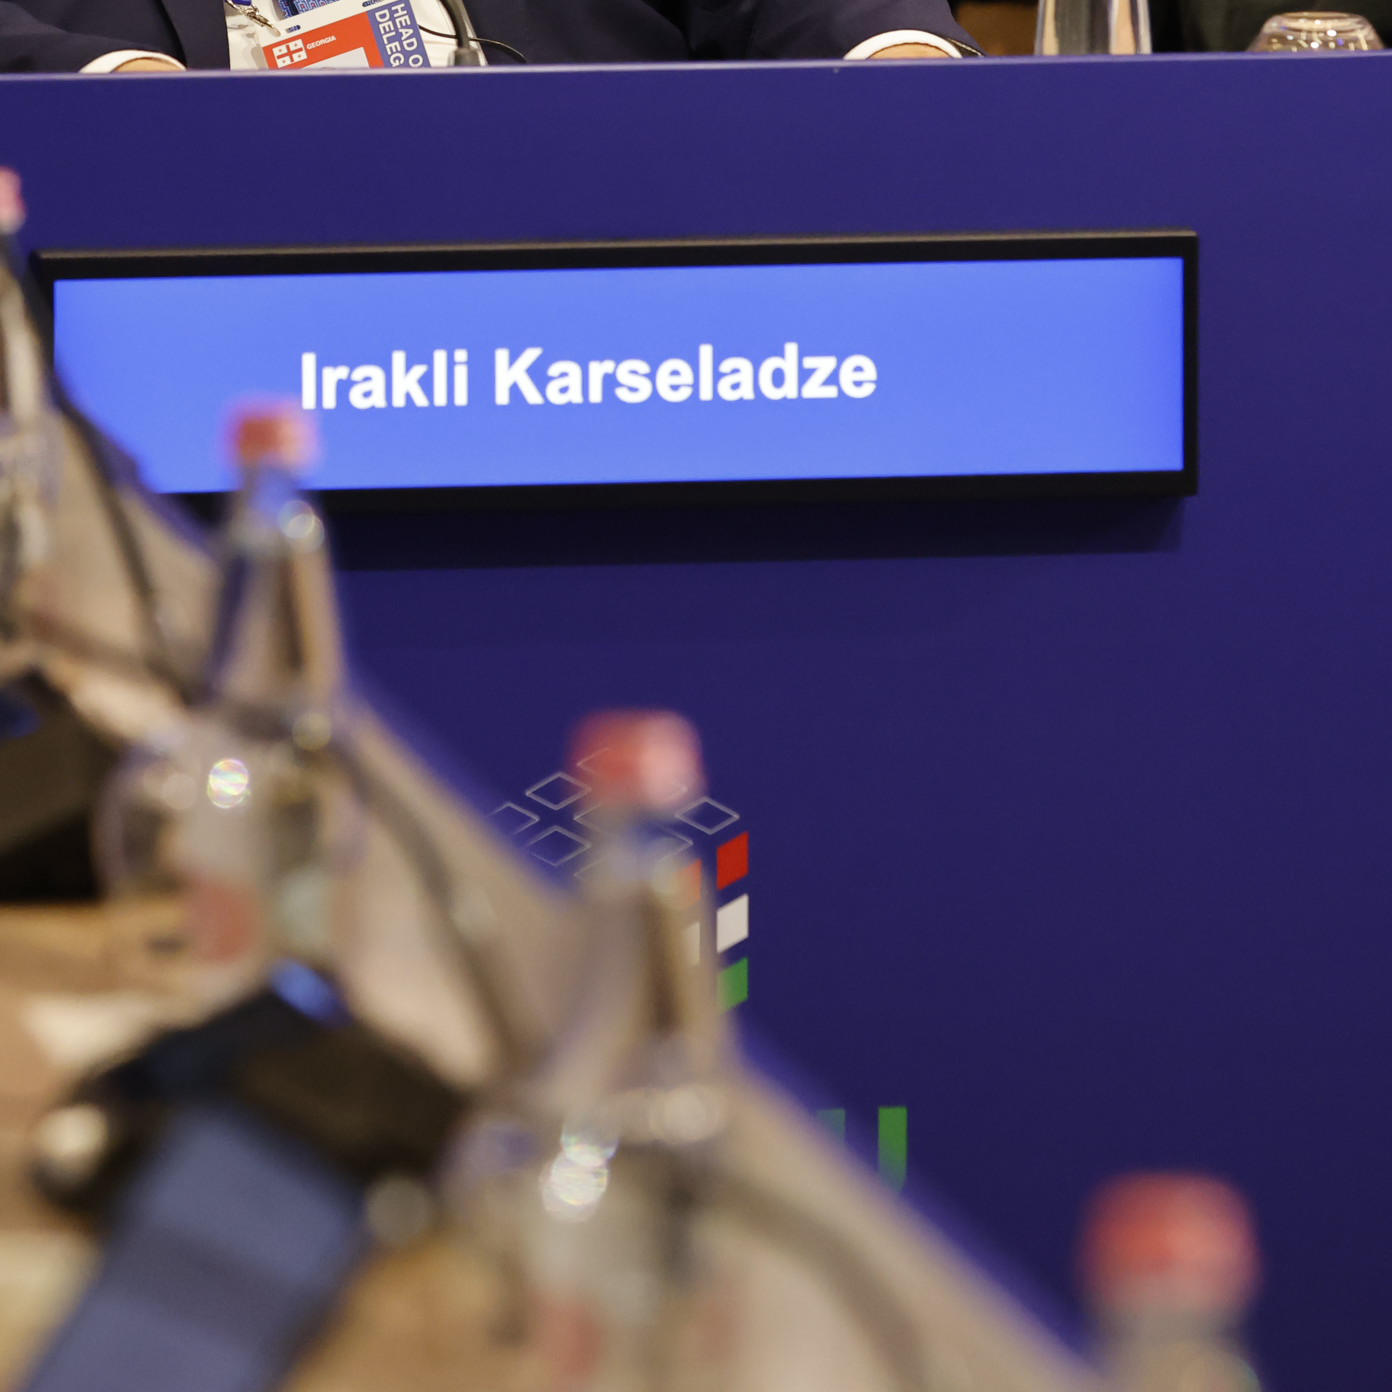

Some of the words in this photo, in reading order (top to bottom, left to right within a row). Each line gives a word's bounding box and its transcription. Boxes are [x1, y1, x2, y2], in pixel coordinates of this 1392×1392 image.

[306, 35, 337, 50] GEORGIA
[391, 3, 419, 51] HEAD
[301, 348, 469, 409] Irakli
[494, 342, 878, 405] Karseladze
